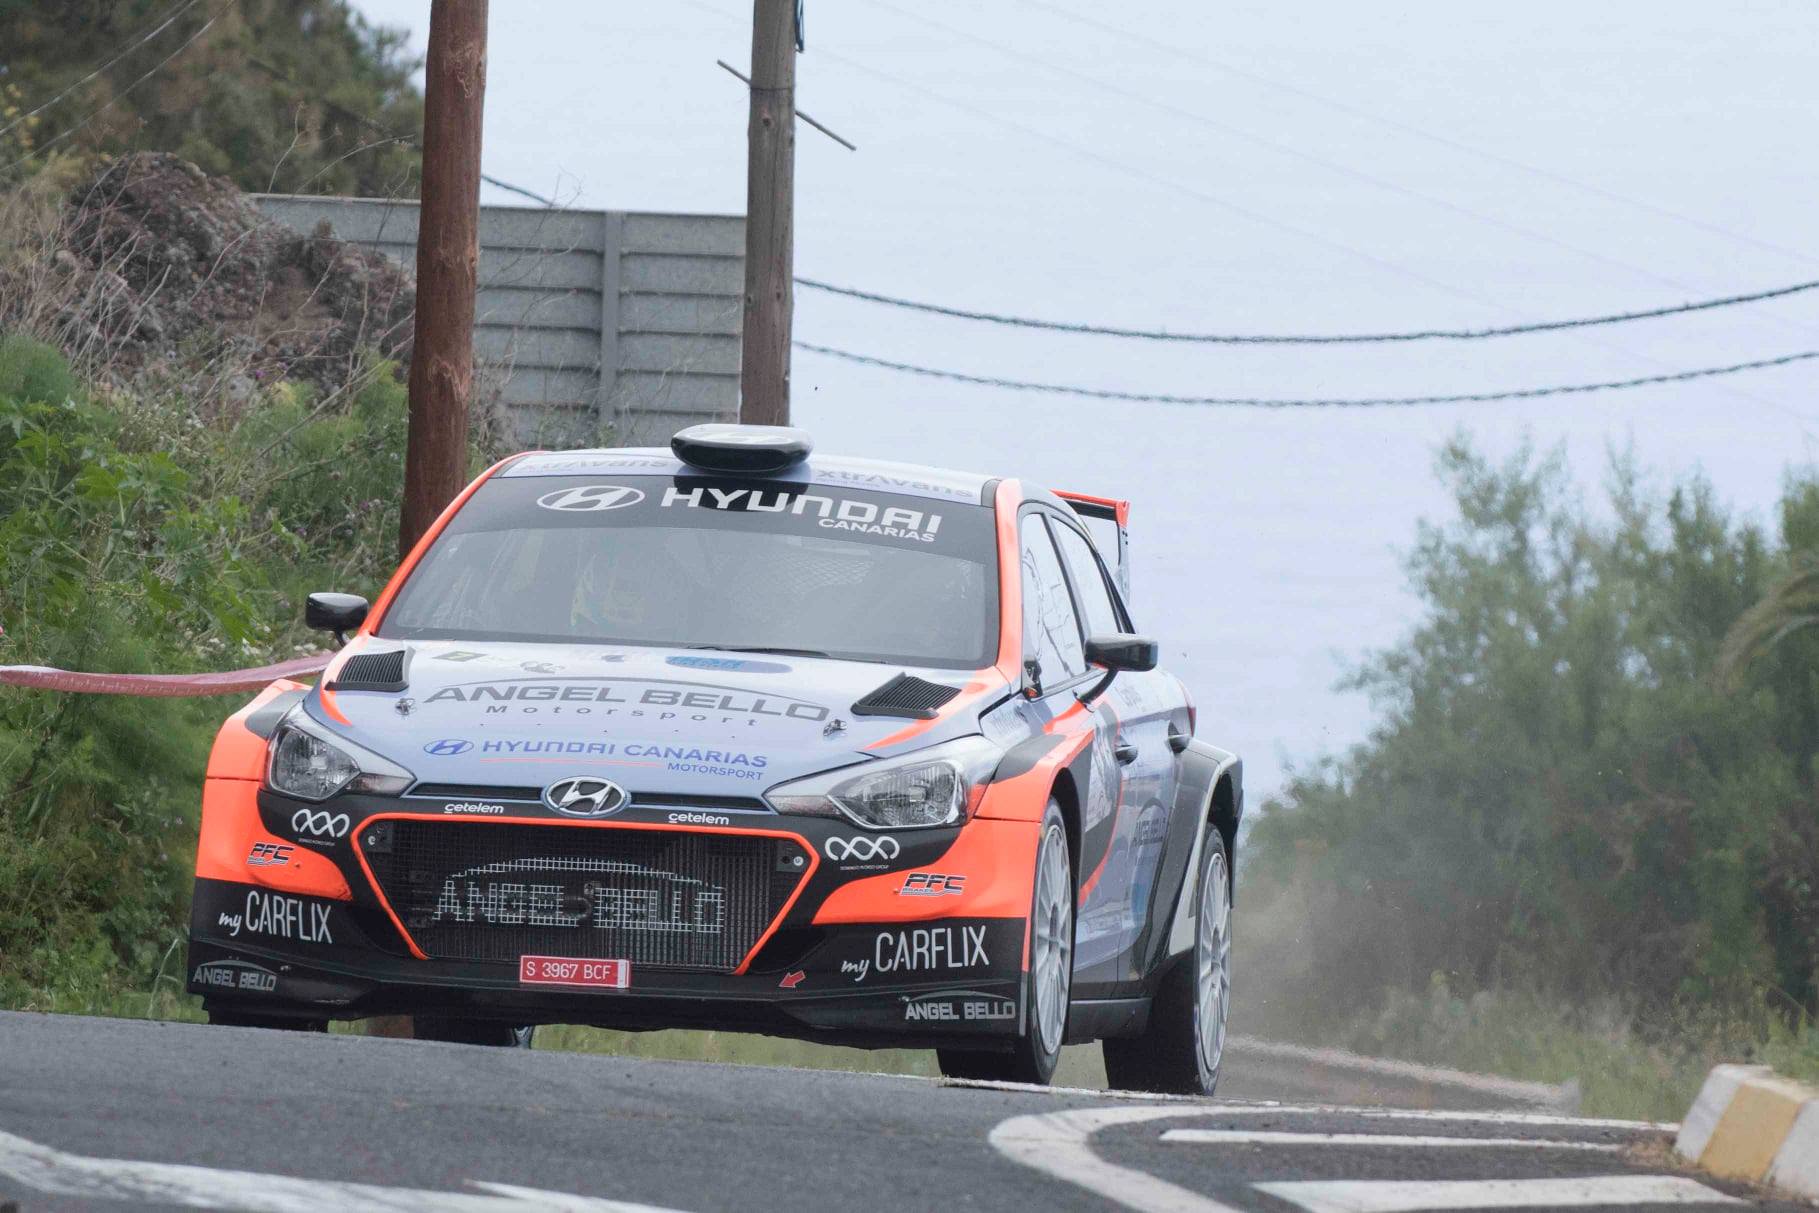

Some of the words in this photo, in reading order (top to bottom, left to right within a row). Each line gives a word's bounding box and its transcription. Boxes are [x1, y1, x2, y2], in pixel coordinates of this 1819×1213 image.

[660, 487, 942, 534] HYUNDAI
[818, 518, 935, 543] CANARIAS
[423, 686, 626, 704] ANGEL
[640, 689, 830, 721] BELLO
[486, 705, 757, 726] Motorsport
[483, 740, 616, 754] HYUNDAI
[624, 744, 768, 768] CANARIAS
[667, 763, 763, 781] MOTORSPORT
[444, 802, 504, 814] cetelem
[668, 812, 729, 825] cetelem
[250, 842, 294, 861] PFC
[904, 872, 966, 890] PFC
[219, 911, 242, 936] my
[246, 891, 333, 944] CARFLIX
[593, 887, 725, 933] BELLO
[841, 959, 870, 982] my
[875, 925, 989, 972] CARFLIX
[192, 965, 235, 987] ANGEL
[239, 971, 277, 991] BELLO
[526, 961, 536, 976] S
[542, 962, 579, 979] 3967
[583, 964, 611, 980] BCF
[904, 1001, 960, 1021] ANGEL
[964, 1001, 1016, 1020] BELLO
